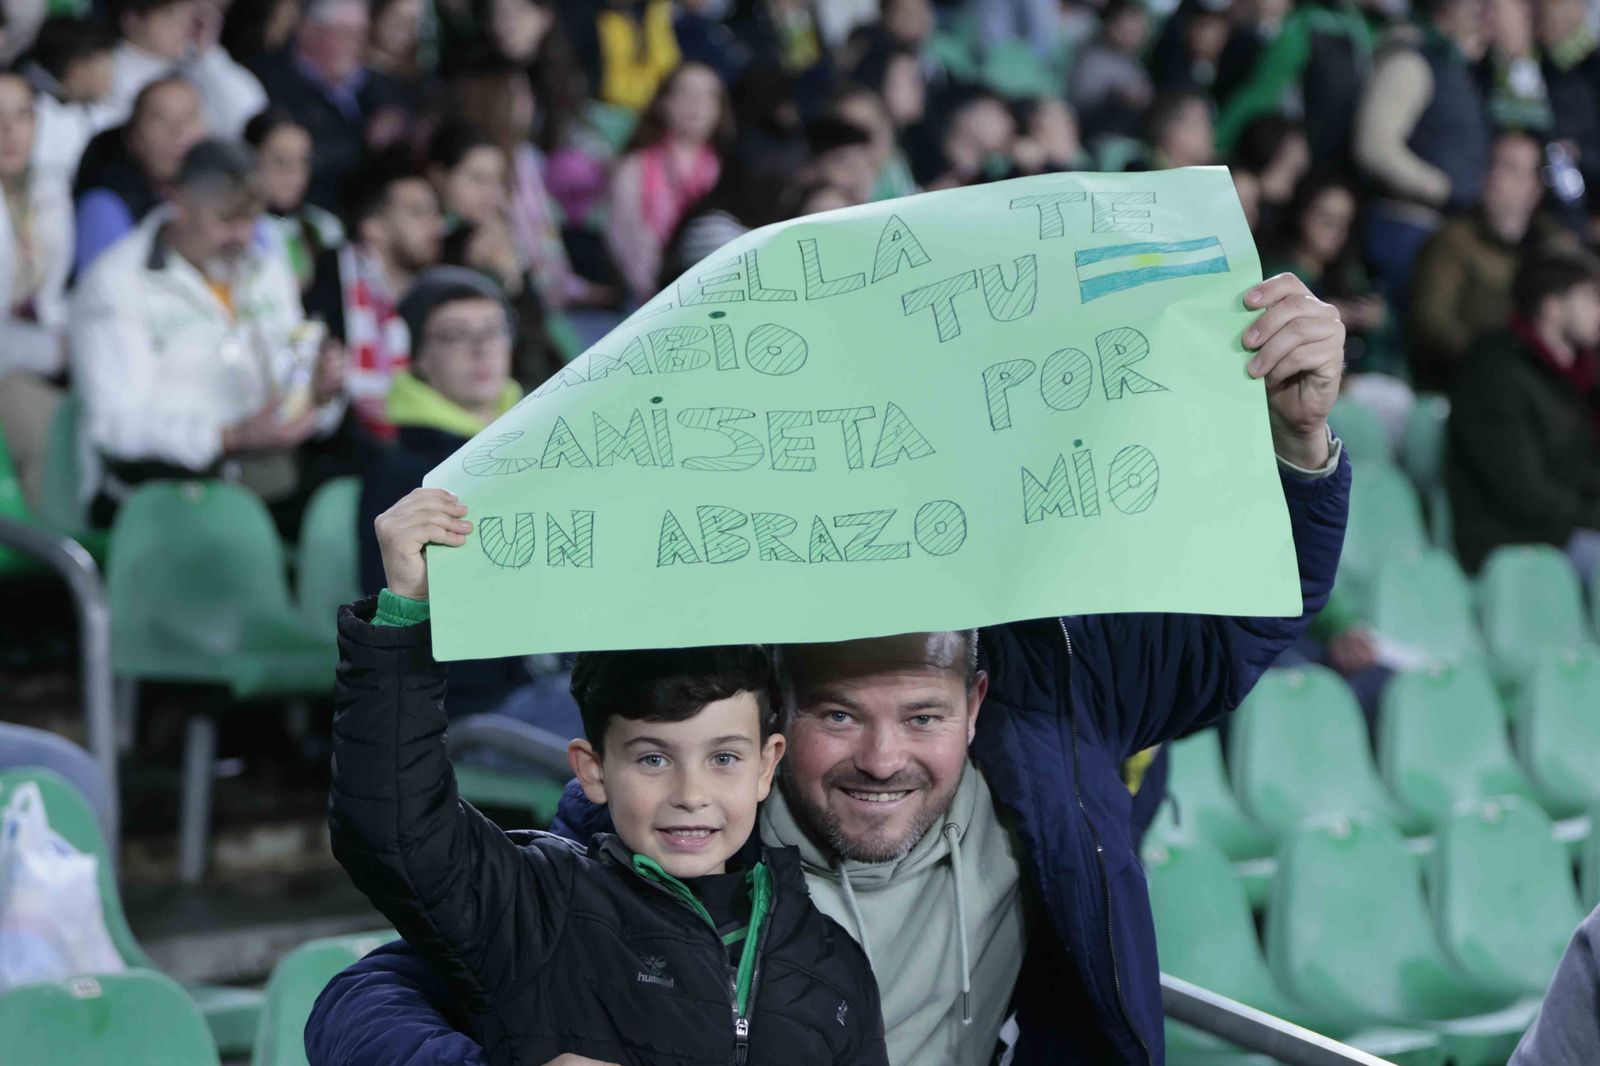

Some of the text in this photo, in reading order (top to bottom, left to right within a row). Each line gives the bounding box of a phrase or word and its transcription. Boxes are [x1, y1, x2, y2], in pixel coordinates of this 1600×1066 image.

[628, 192, 1157, 326] ELLA TE
[463, 326, 1171, 476] CAMISETA POR
[518, 254, 1038, 410] AMBIO TU
[479, 439, 1160, 569] UN ABRAZO MIO
